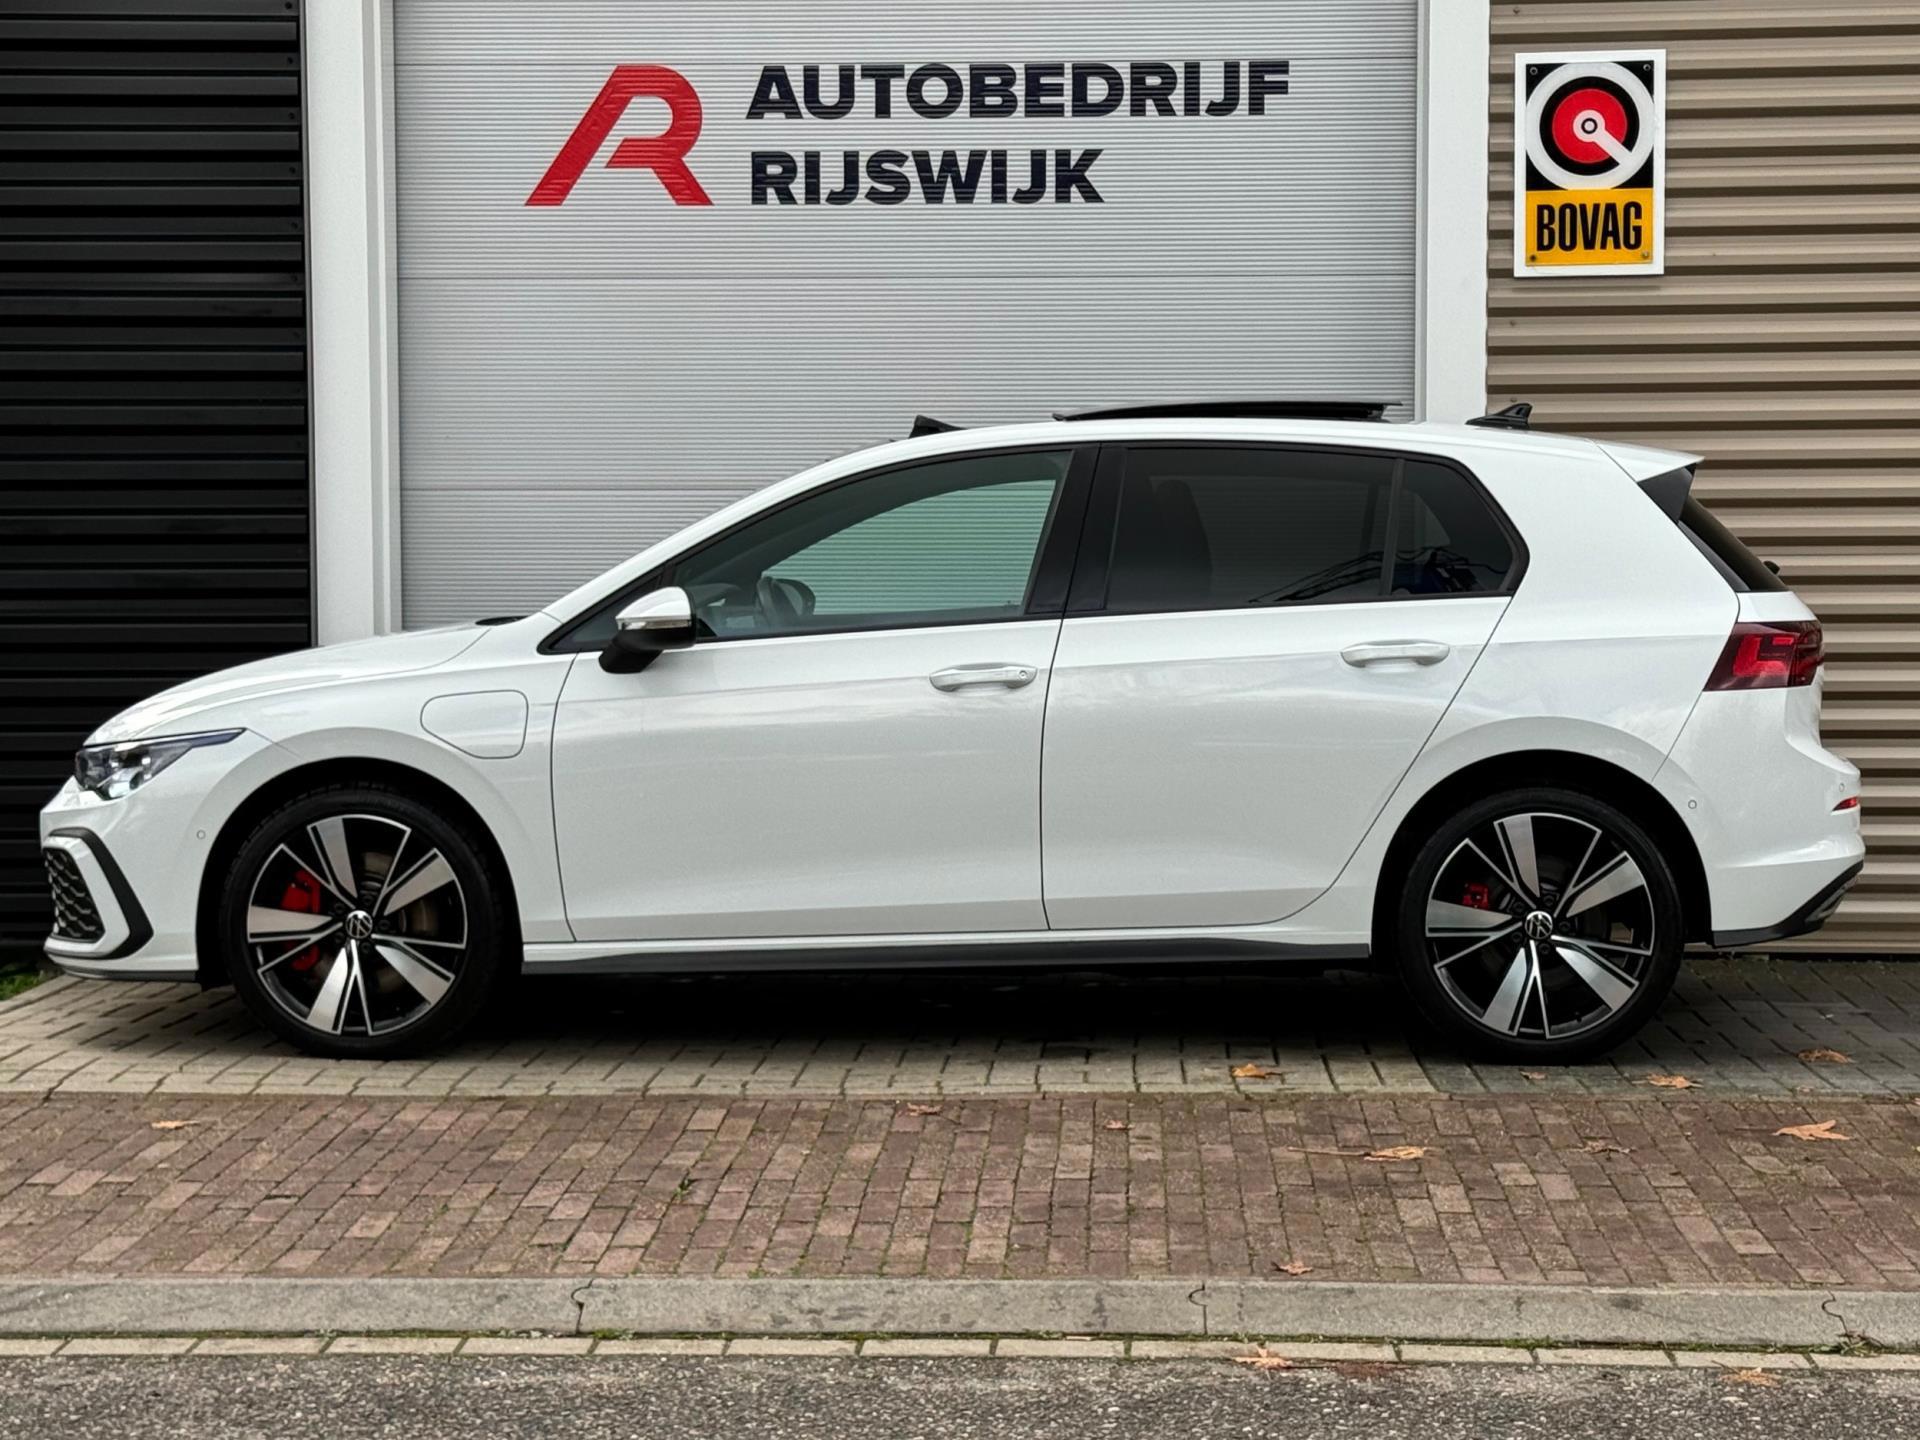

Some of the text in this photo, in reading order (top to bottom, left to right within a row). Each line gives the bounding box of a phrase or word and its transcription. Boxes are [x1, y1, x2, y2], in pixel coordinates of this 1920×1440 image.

[746, 61, 1290, 119] AUTOBEDRIJF
[751, 149, 1104, 205] RIJSWIJK
[1537, 201, 1642, 252] BOVAG
